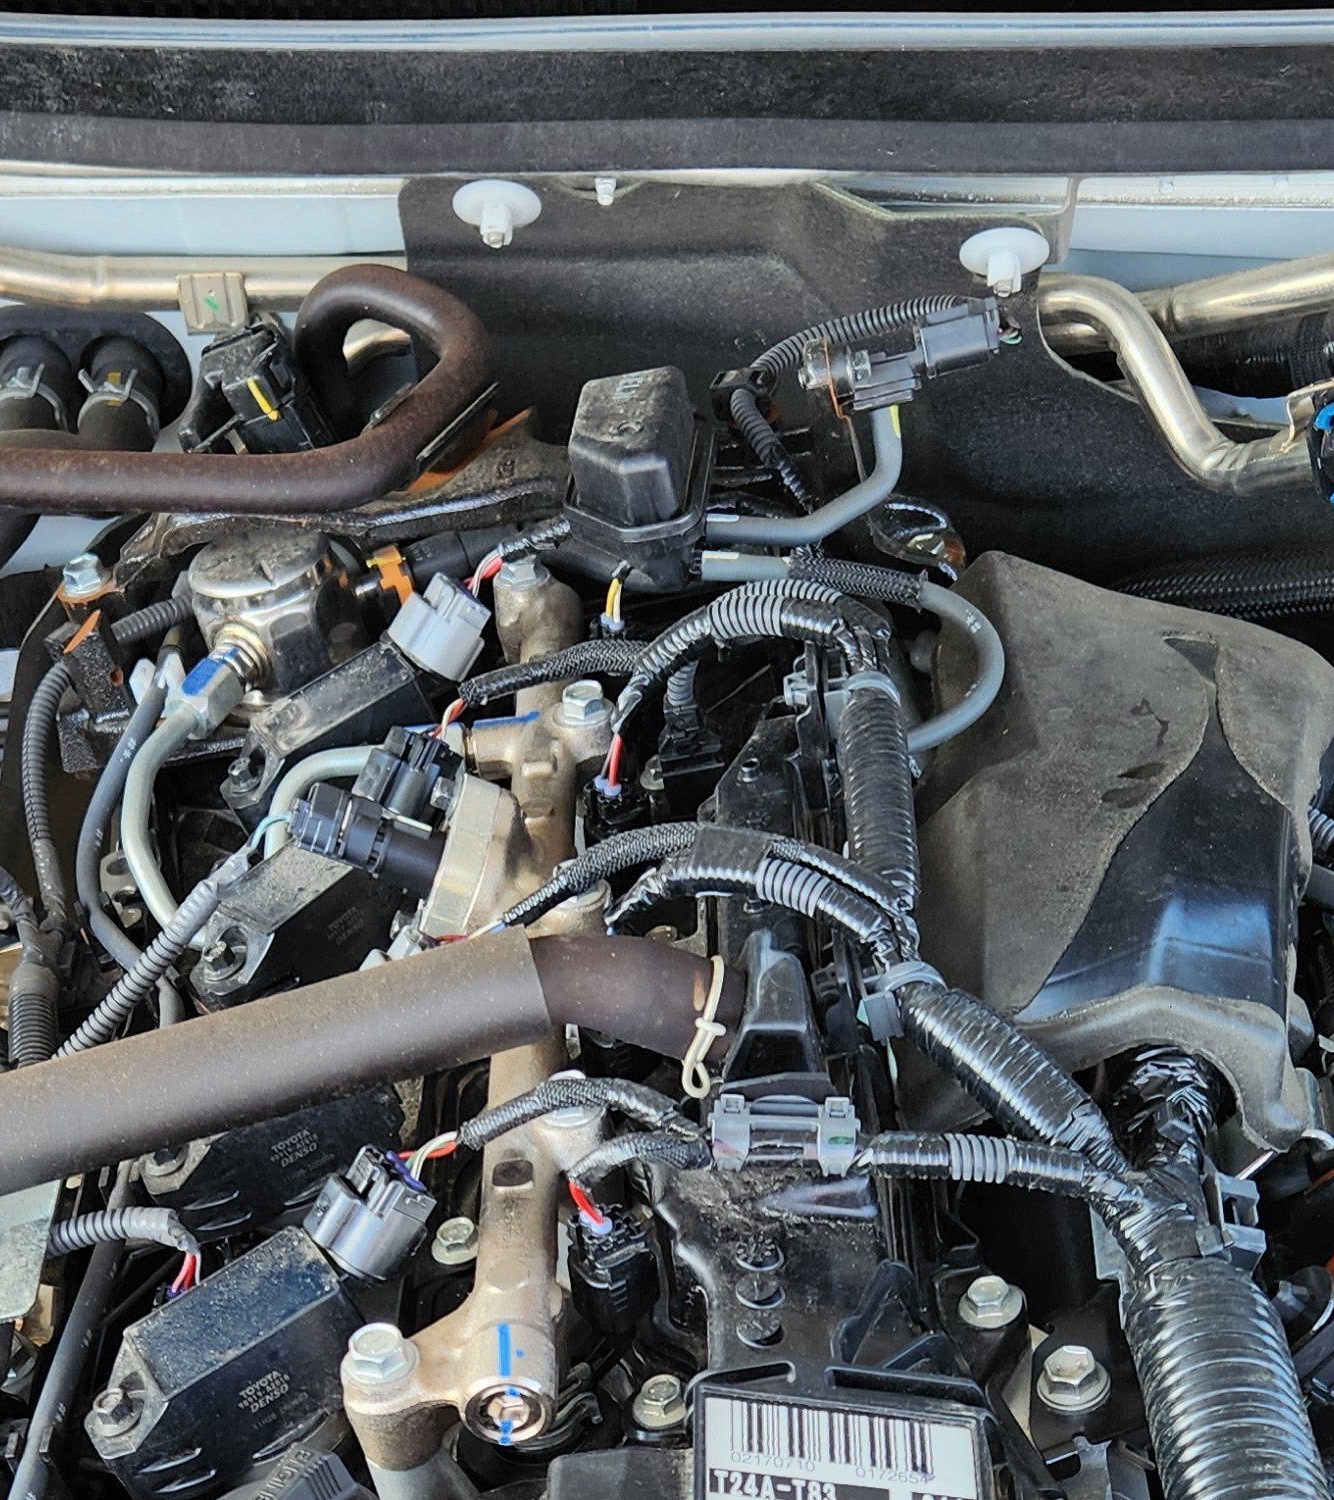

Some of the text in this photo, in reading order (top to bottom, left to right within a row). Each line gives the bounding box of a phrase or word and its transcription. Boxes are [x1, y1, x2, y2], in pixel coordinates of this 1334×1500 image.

[271, 1129, 310, 1153] TOYOTA
[281, 1142, 317, 1168] DENSO
[238, 1370, 282, 1399] TOYOTA
[250, 1383, 289, 1414] DENSO
[731, 1451, 815, 1472] 02170710
